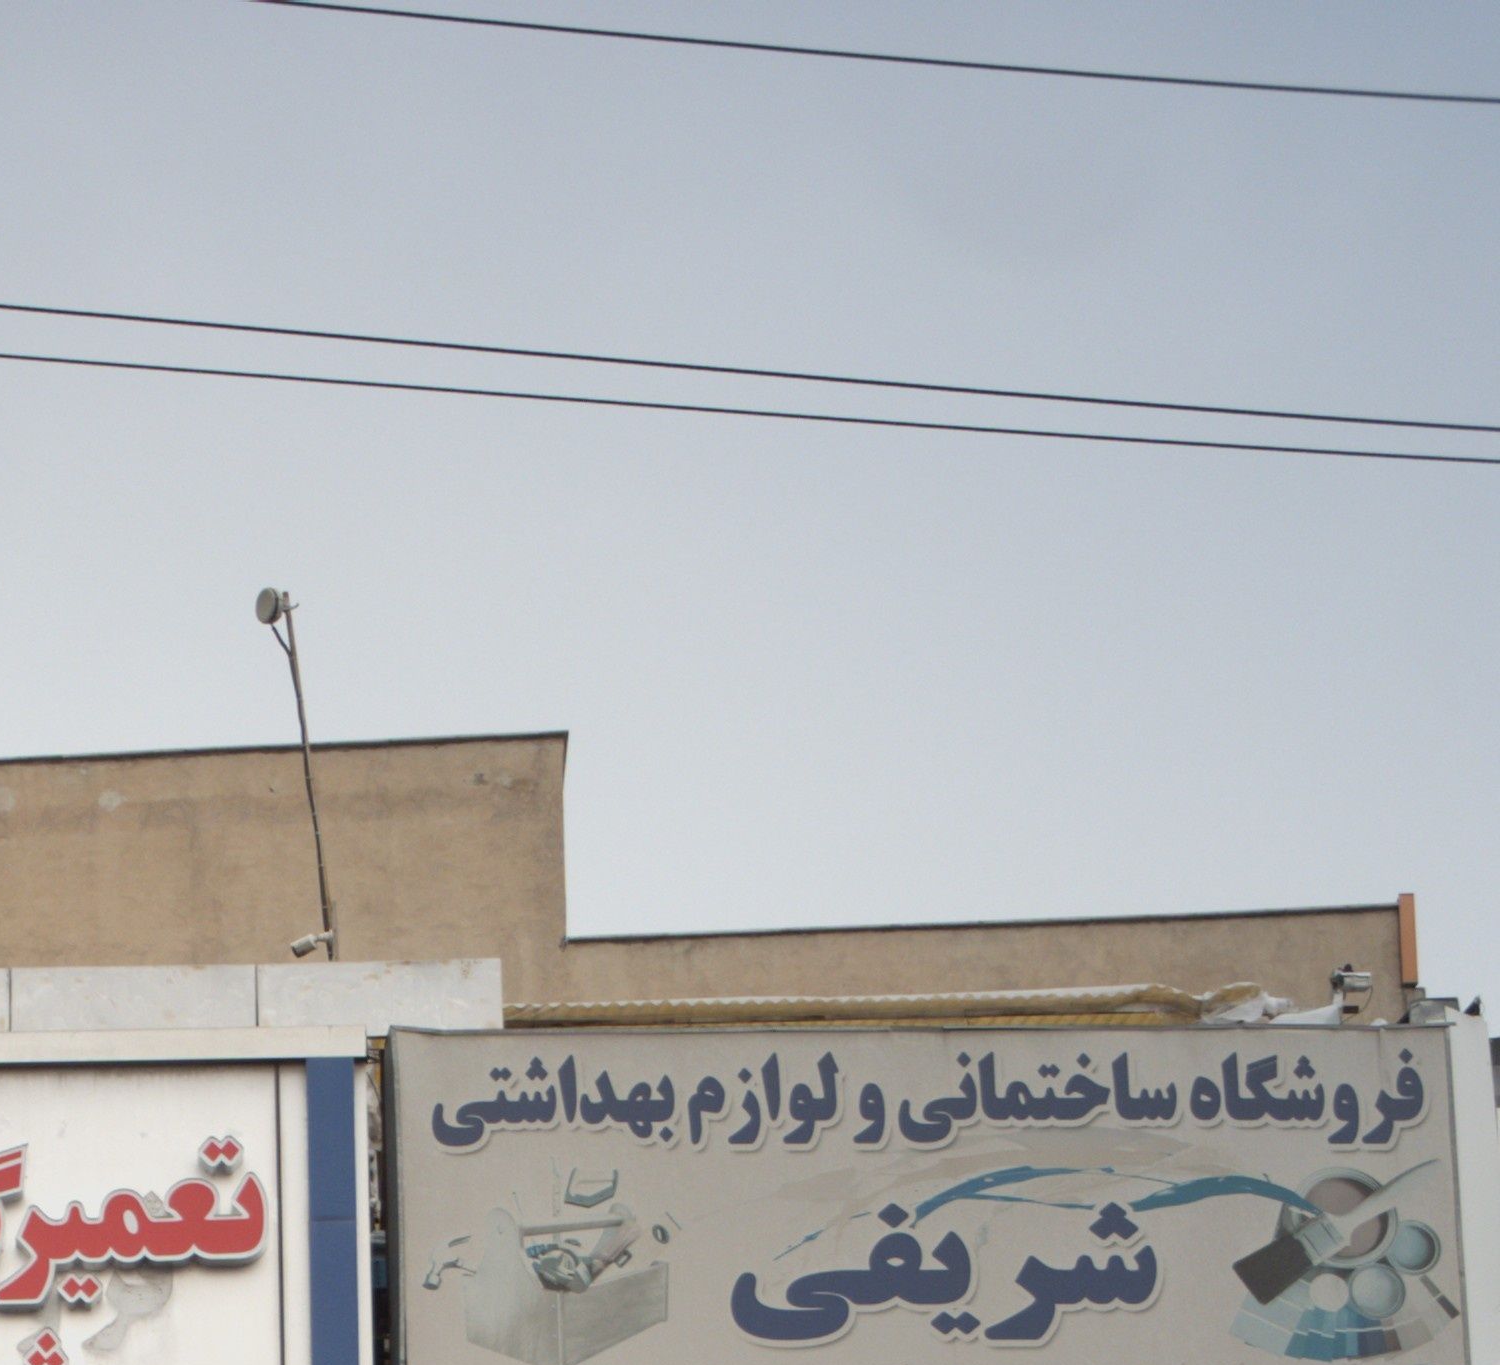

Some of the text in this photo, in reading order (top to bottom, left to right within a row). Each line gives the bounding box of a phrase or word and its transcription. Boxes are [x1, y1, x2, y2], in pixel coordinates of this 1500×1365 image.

[431, 1046, 1428, 1152] فروشگاه ساختمانی و لوازم بهداشتی
[730, 1200, 1160, 1345] شریفی
